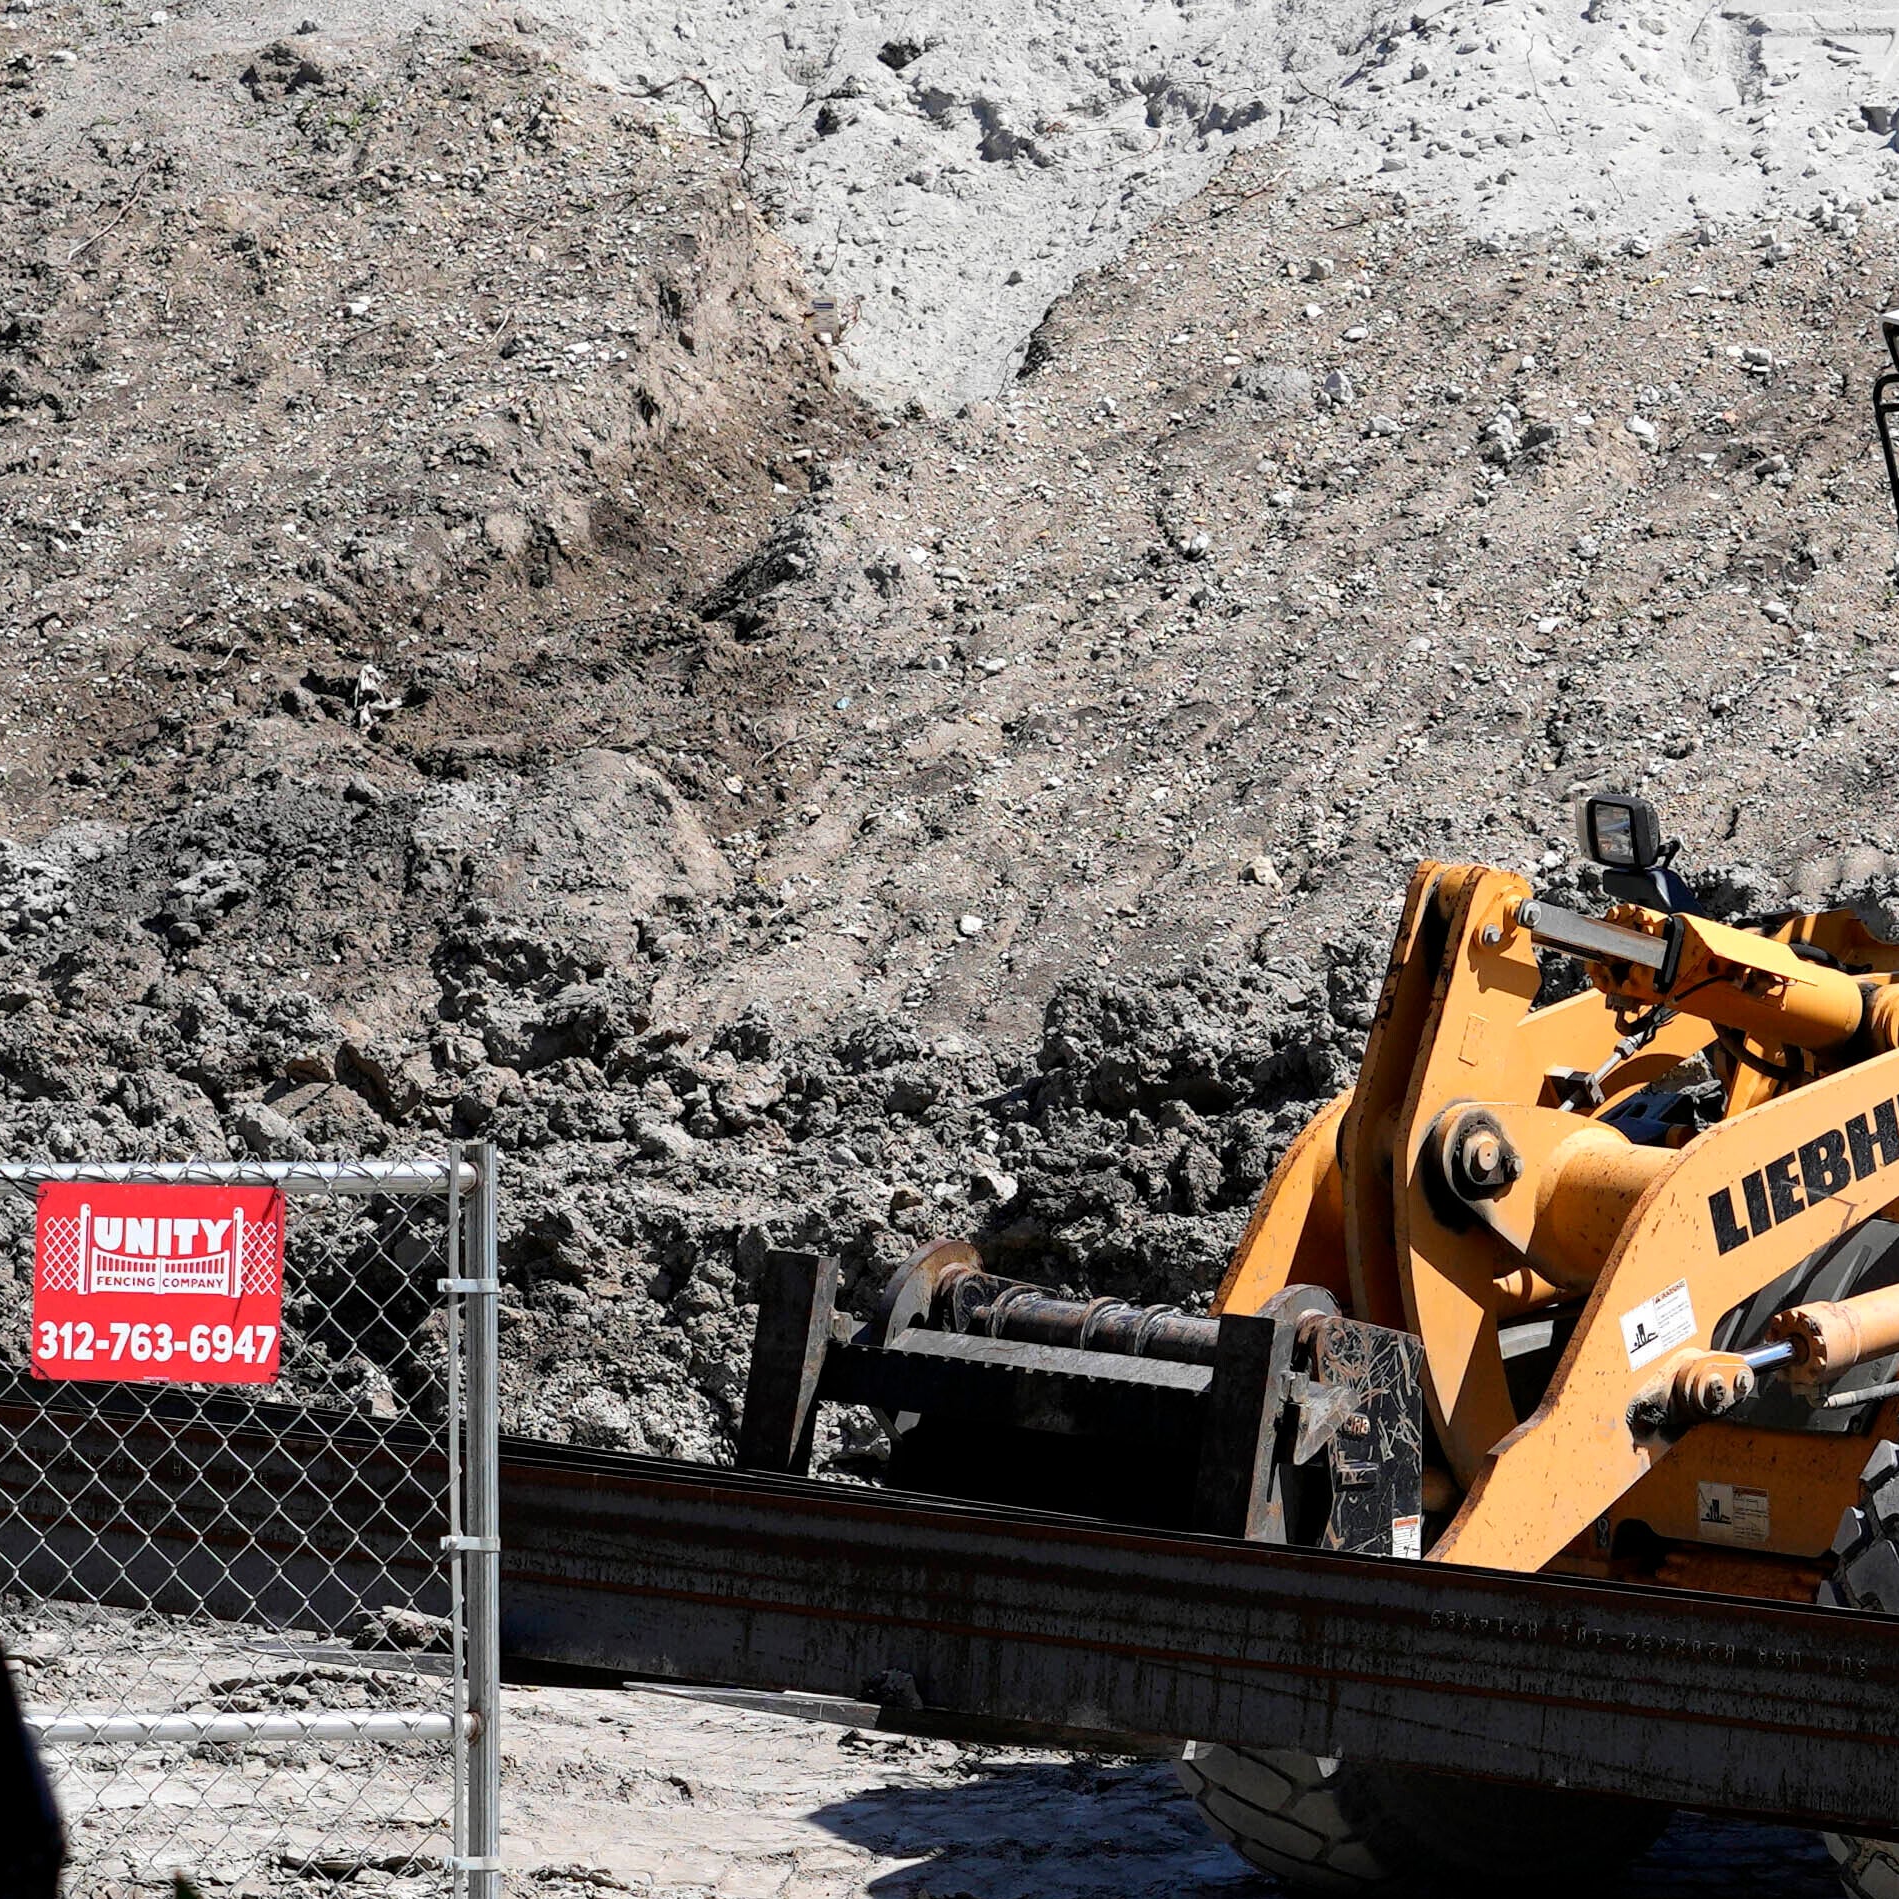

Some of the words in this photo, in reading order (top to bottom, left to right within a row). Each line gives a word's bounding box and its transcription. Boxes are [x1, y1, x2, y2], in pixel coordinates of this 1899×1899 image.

[93, 1216, 234, 1257] UNITY
[97, 1276, 156, 1288] FENCING
[162, 1278, 224, 1289] COMPANY
[37, 1321, 277, 1364] 312-763-6947
